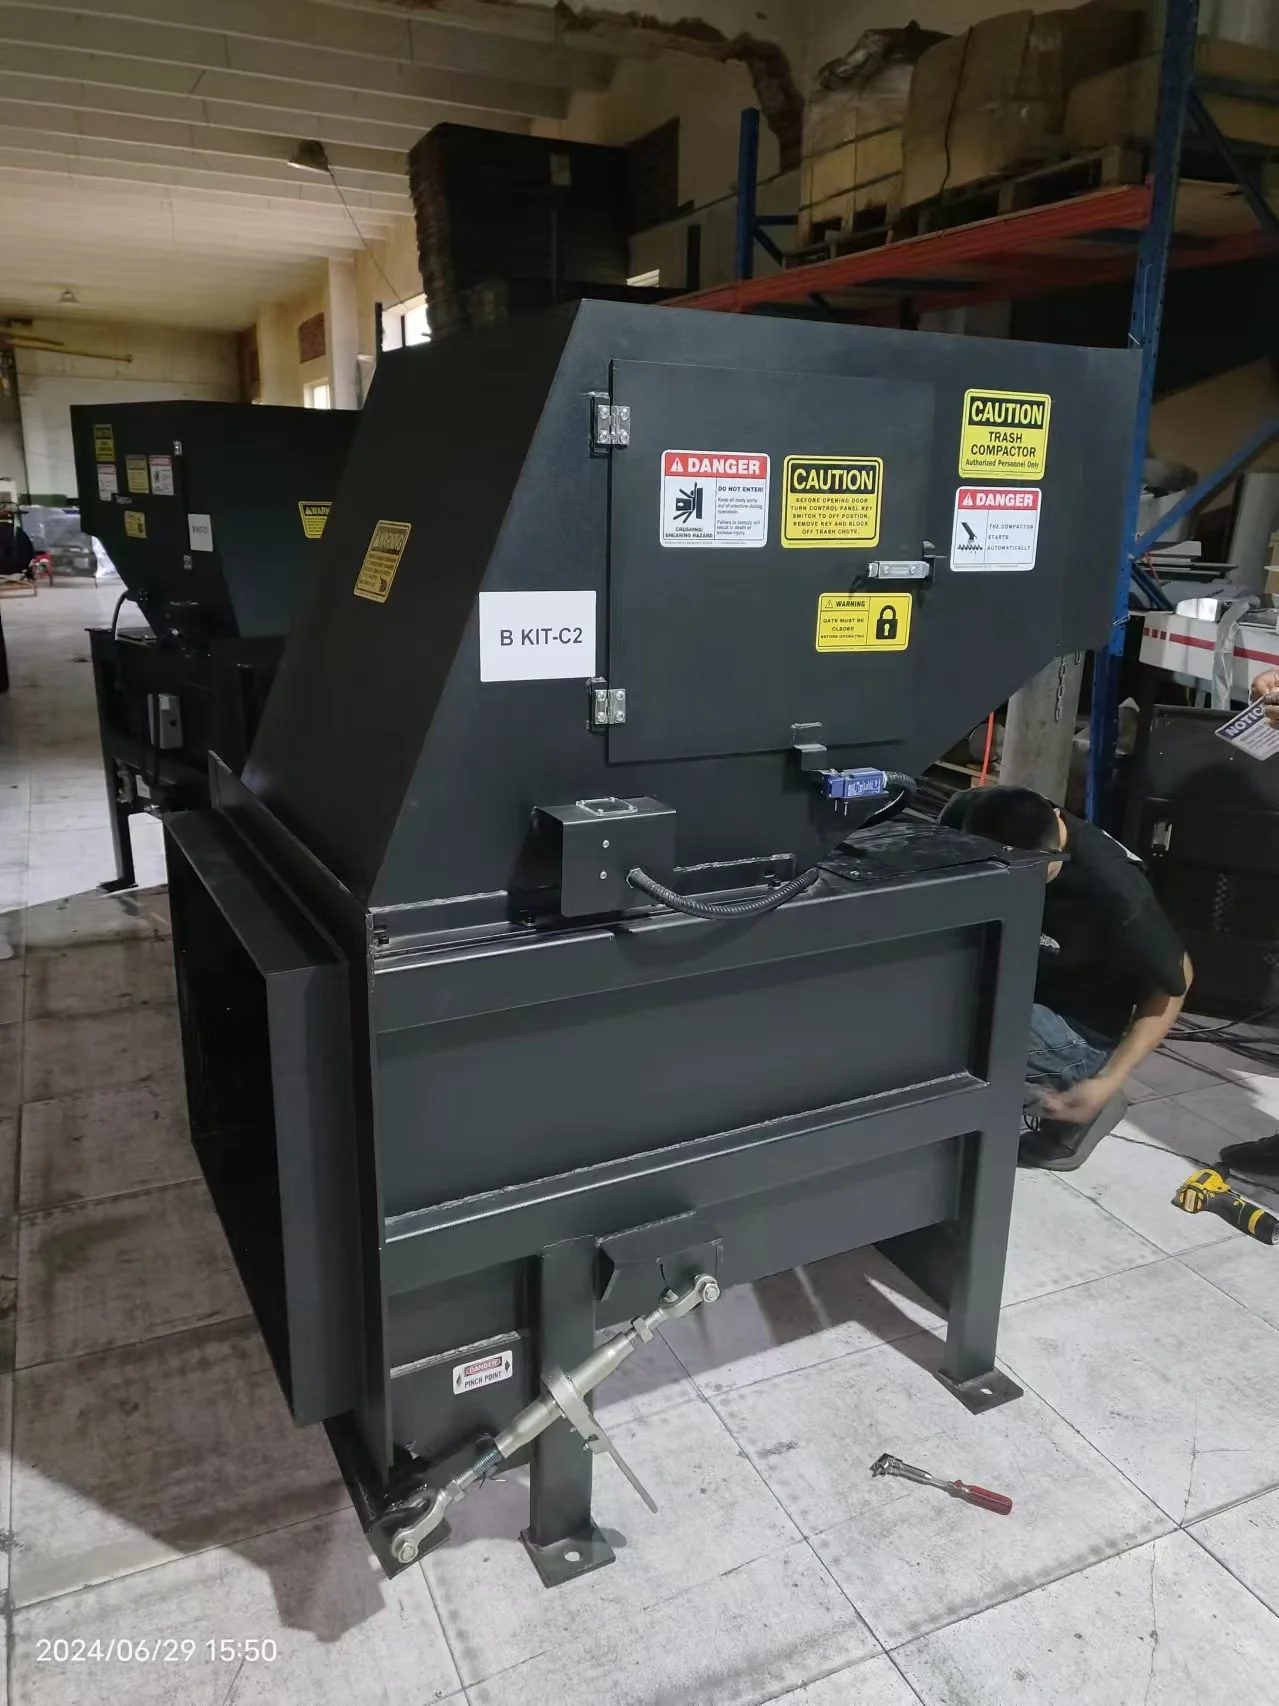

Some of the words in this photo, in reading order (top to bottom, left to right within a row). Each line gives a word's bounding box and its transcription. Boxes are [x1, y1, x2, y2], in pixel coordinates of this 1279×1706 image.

[971, 400, 1043, 425] CAUTION
[989, 431, 1022, 443] TRASH
[971, 444, 1036, 457] COMPACTOR
[688, 457, 760, 474] DANGER
[965, 458, 996, 466] Authorized
[1027, 461, 1039, 469] Only
[793, 468, 873, 490] CAUTION
[976, 493, 1033, 507] DANGER
[500, 629, 514, 646] B
[521, 627, 583, 646] KIT-C2
[1225, 704, 1264, 736] NOTIC
[464, 1377, 483, 1388] PINCH
[485, 1371, 501, 1382] POINT
